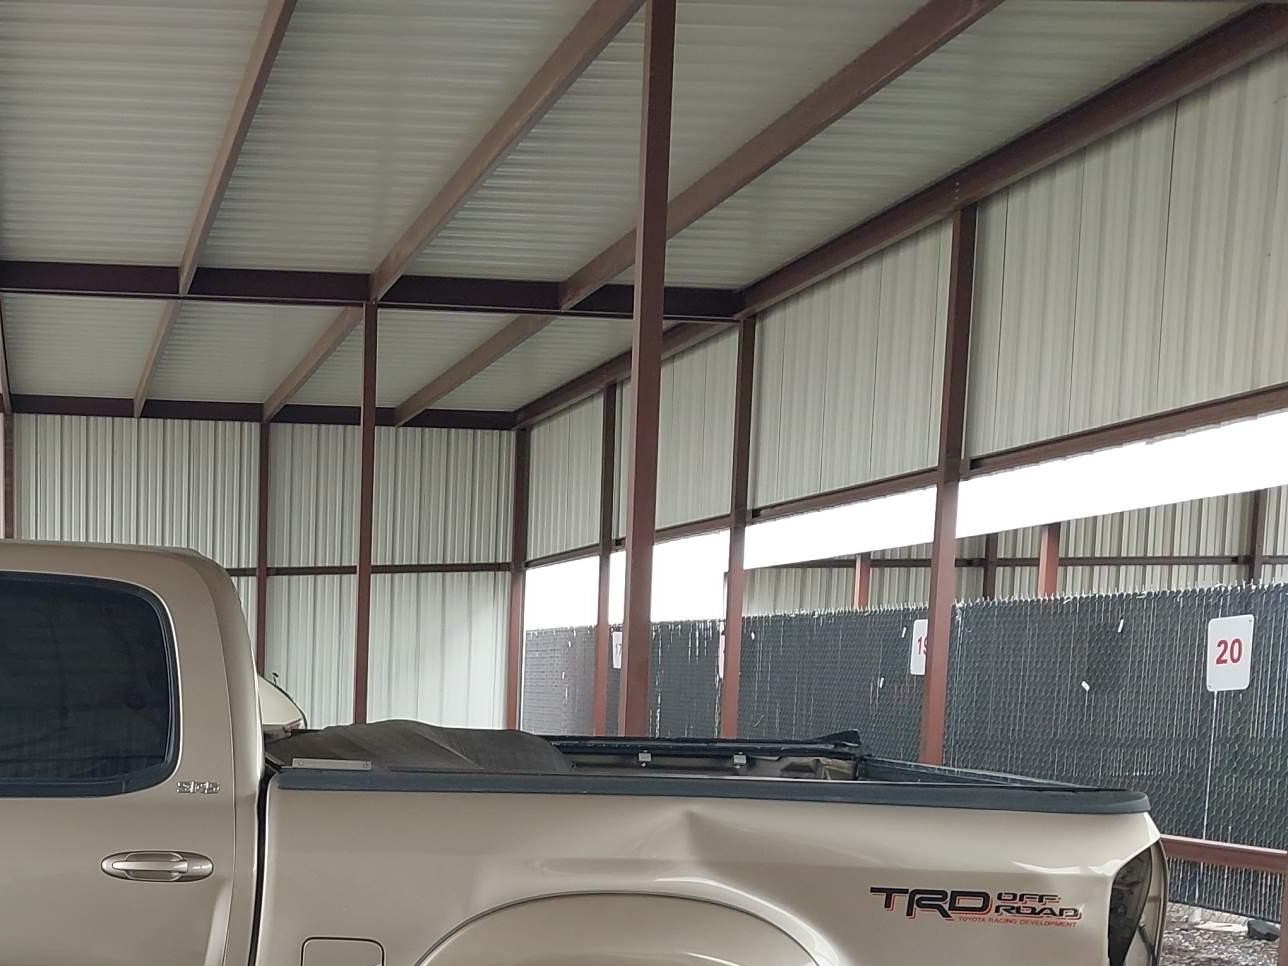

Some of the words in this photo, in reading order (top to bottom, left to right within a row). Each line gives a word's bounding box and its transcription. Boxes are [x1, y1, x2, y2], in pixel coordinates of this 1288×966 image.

[1215, 638, 1243, 665] 20
[870, 887, 992, 921] TRD
[996, 891, 1062, 905] OFF
[994, 904, 1082, 920] ROAD
